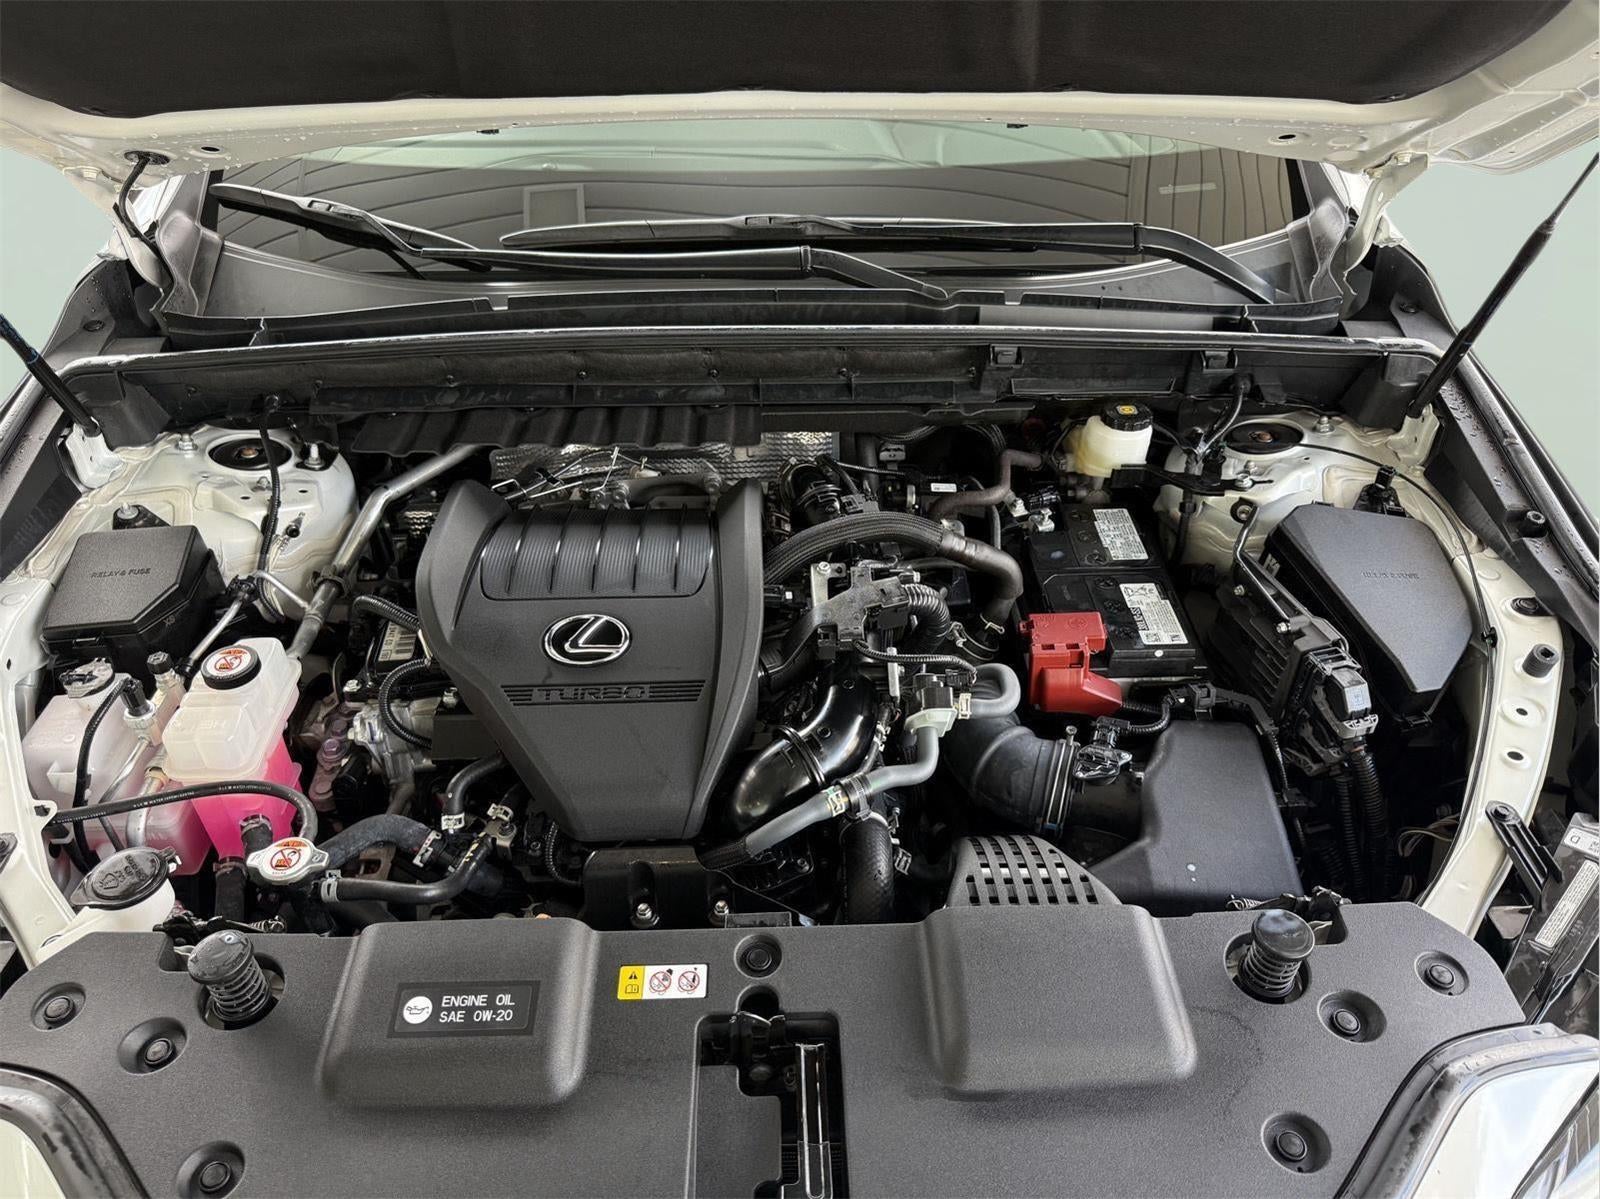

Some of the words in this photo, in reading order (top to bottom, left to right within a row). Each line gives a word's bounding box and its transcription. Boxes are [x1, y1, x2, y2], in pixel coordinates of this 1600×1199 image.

[537, 686, 645, 700] TURBO
[441, 994, 488, 1007] ENGINE
[495, 993, 515, 1006] OIL
[439, 1010, 466, 1023] SAE
[473, 1009, 513, 1022] 0W-20
